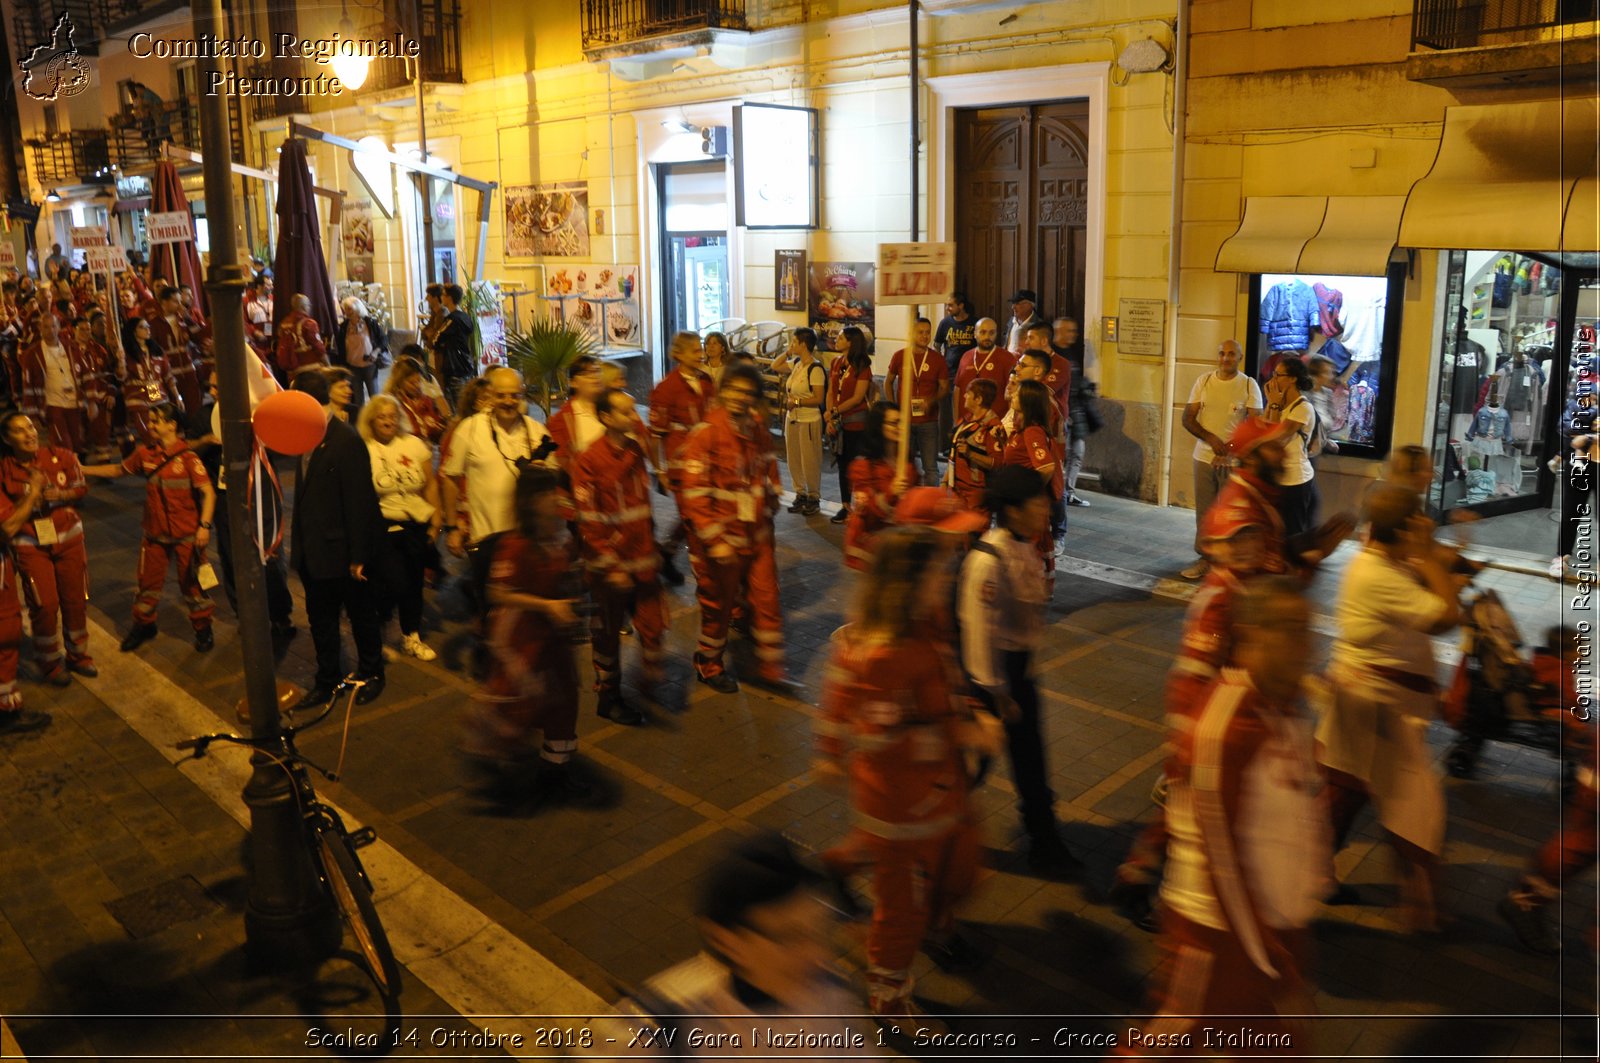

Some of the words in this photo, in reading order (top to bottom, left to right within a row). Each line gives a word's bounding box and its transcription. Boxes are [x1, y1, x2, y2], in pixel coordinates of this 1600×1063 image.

[151, 225, 188, 240] UMBRIA
[73, 236, 106, 247] MARCHE
[882, 271, 949, 297] LAZIO
